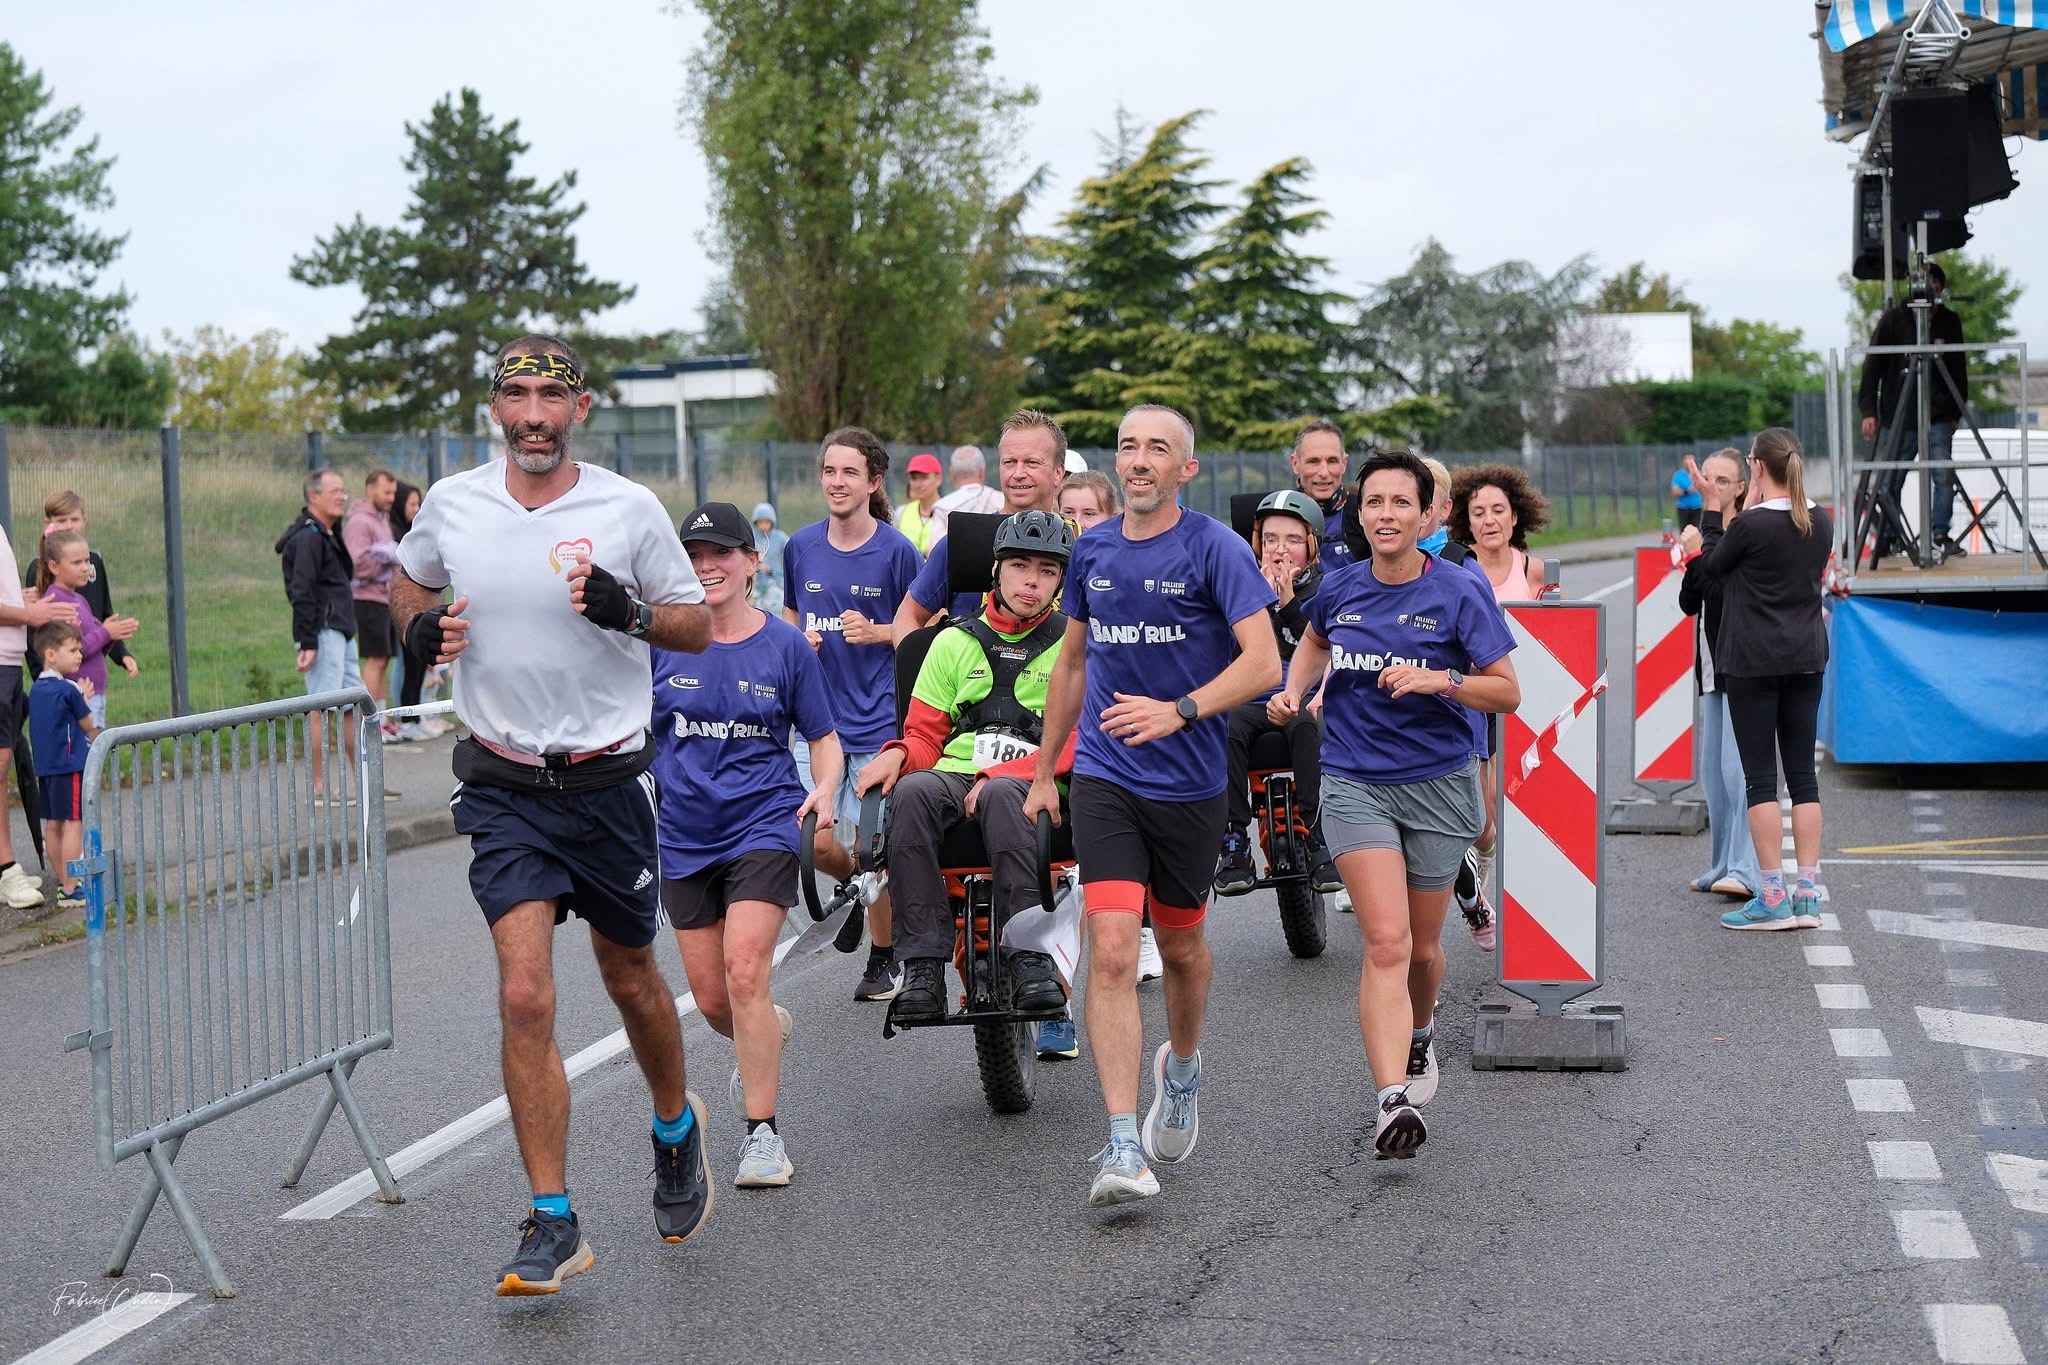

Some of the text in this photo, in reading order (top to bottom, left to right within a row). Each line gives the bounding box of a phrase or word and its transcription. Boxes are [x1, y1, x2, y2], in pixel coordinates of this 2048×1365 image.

[690, 521, 714, 531] adidas
[1414, 615, 1438, 625] RILLIEUX
[1088, 616, 1187, 643] BAND'RILL
[1413, 621, 1436, 631] LA-PAPE
[672, 711, 771, 740] BAND'RILL
